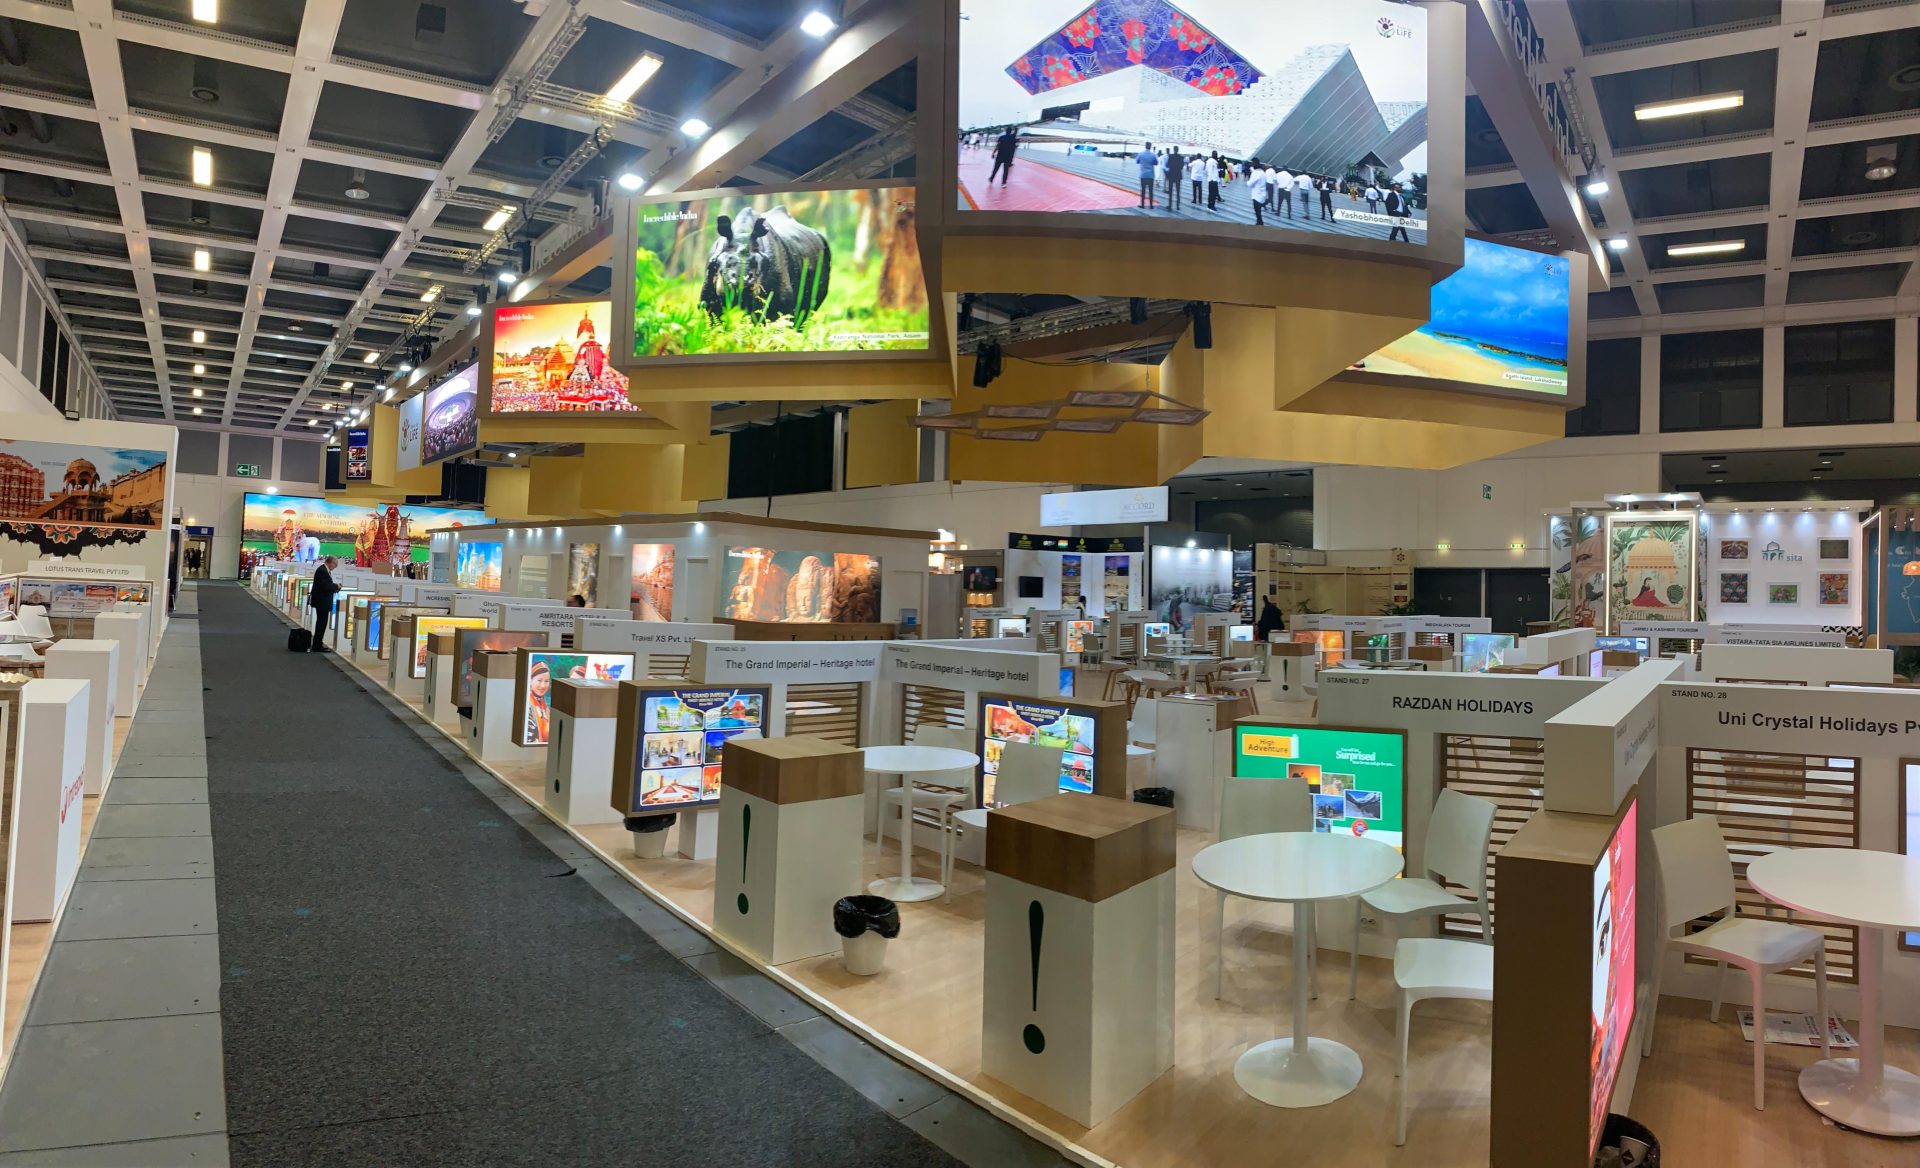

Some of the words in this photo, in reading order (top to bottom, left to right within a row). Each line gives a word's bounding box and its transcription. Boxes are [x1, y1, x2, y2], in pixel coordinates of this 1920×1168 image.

[644, 211, 679, 223] Incredible
[1340, 210, 1396, 225] Yashobhoomi,
[1399, 218, 1419, 227] Delhi
[1786, 553, 1803, 561] sita
[632, 634, 654, 642] Travel
[726, 660, 743, 669] The
[746, 660, 773, 669] Grand
[776, 659, 810, 670] Imperial
[820, 659, 853, 669] Heritage
[856, 658, 875, 667] hotel
[896, 659, 908, 668] The
[910, 660, 931, 671] Grand
[933, 663, 963, 675] Imperial
[971, 667, 1005, 680] Heritage
[1007, 670, 1029, 681] hotel
[1393, 696, 1452, 710] RAZDAN
[1457, 699, 1533, 714] HOLIDAYS
[1719, 711, 1746, 725] Uni
[1752, 713, 1813, 730] Crystal
[1820, 716, 1898, 736] Holidays
[1905, 720, 1920, 734] P
[1248, 744, 1288, 753] Adventure
[1336, 750, 1376, 761] Surprised
